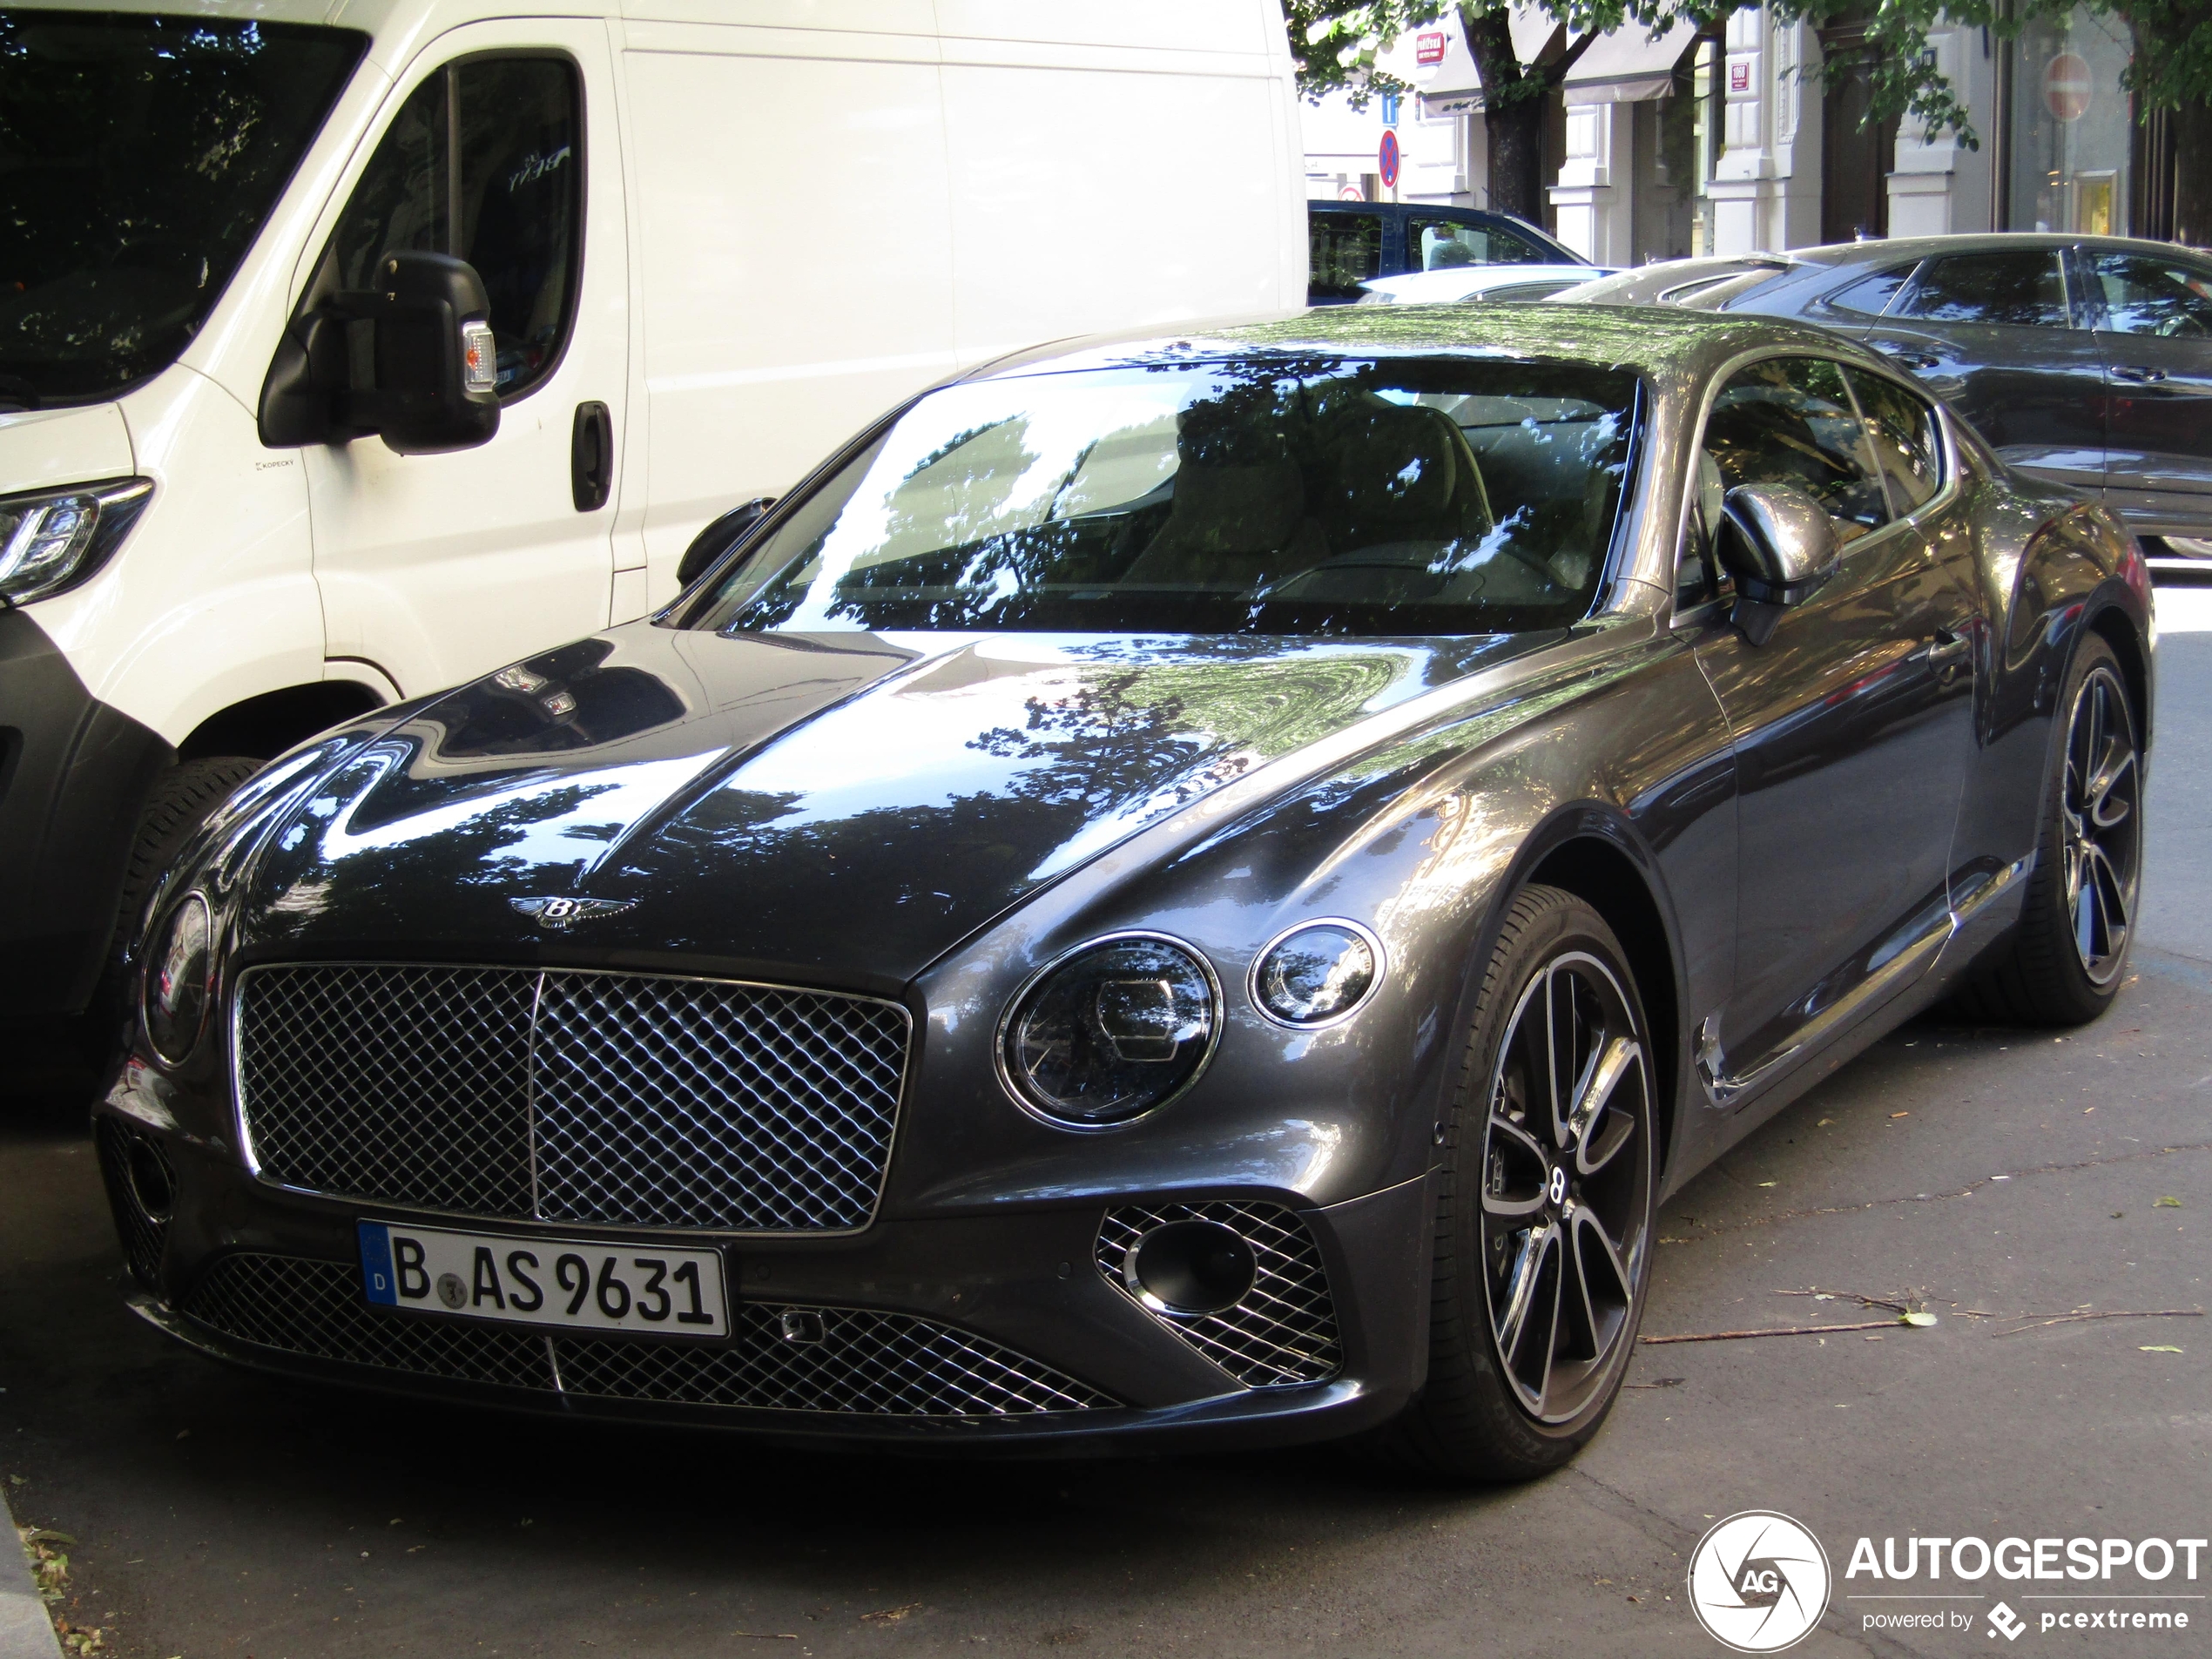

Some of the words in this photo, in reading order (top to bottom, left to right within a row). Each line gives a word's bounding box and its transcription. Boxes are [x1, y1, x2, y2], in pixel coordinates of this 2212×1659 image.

[544, 900, 573, 917] B
[374, 1273, 386, 1291] D
[394, 1237, 431, 1298] B
[473, 1246, 543, 1312] AS
[556, 1253, 714, 1325] 9631
